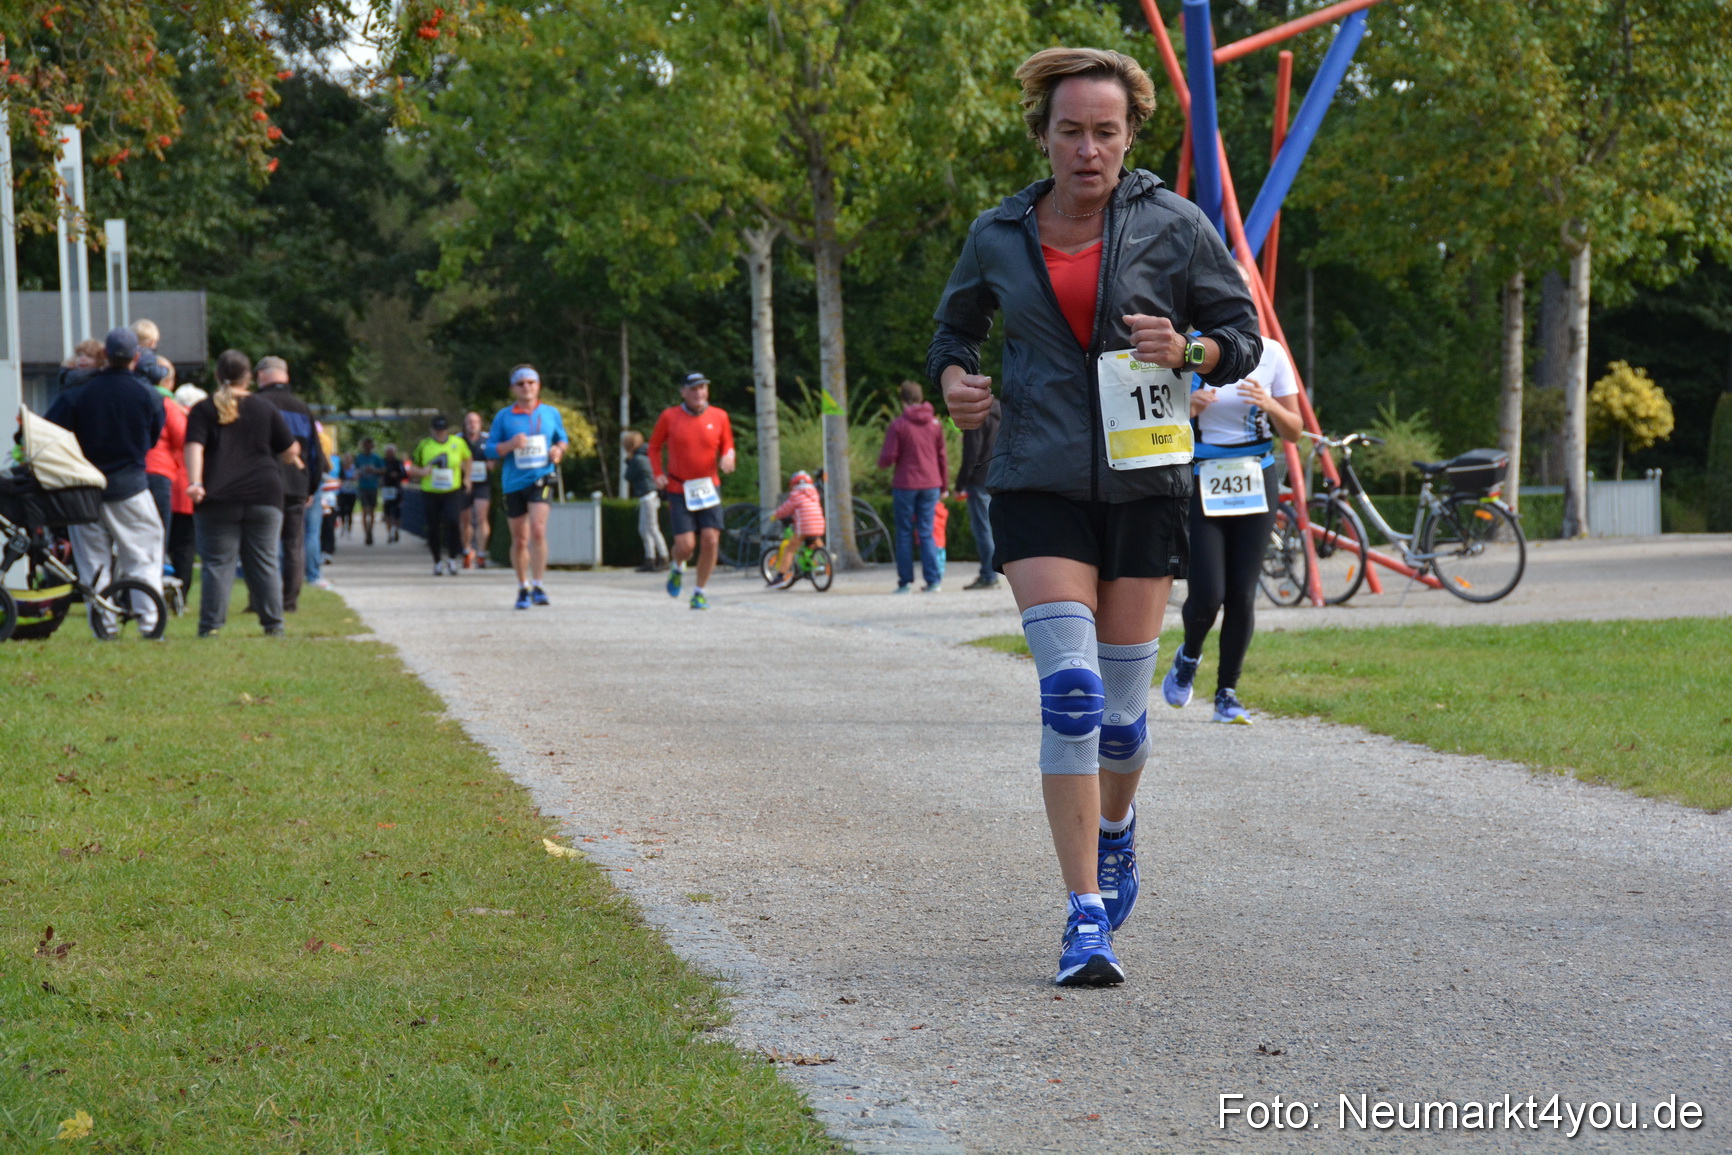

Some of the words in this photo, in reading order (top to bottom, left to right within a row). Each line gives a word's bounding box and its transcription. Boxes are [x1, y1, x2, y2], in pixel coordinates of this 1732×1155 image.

[1110, 419, 1116, 427] D
[1151, 433, 1174, 445] Ilona
[1210, 475, 1252, 495] 2431
